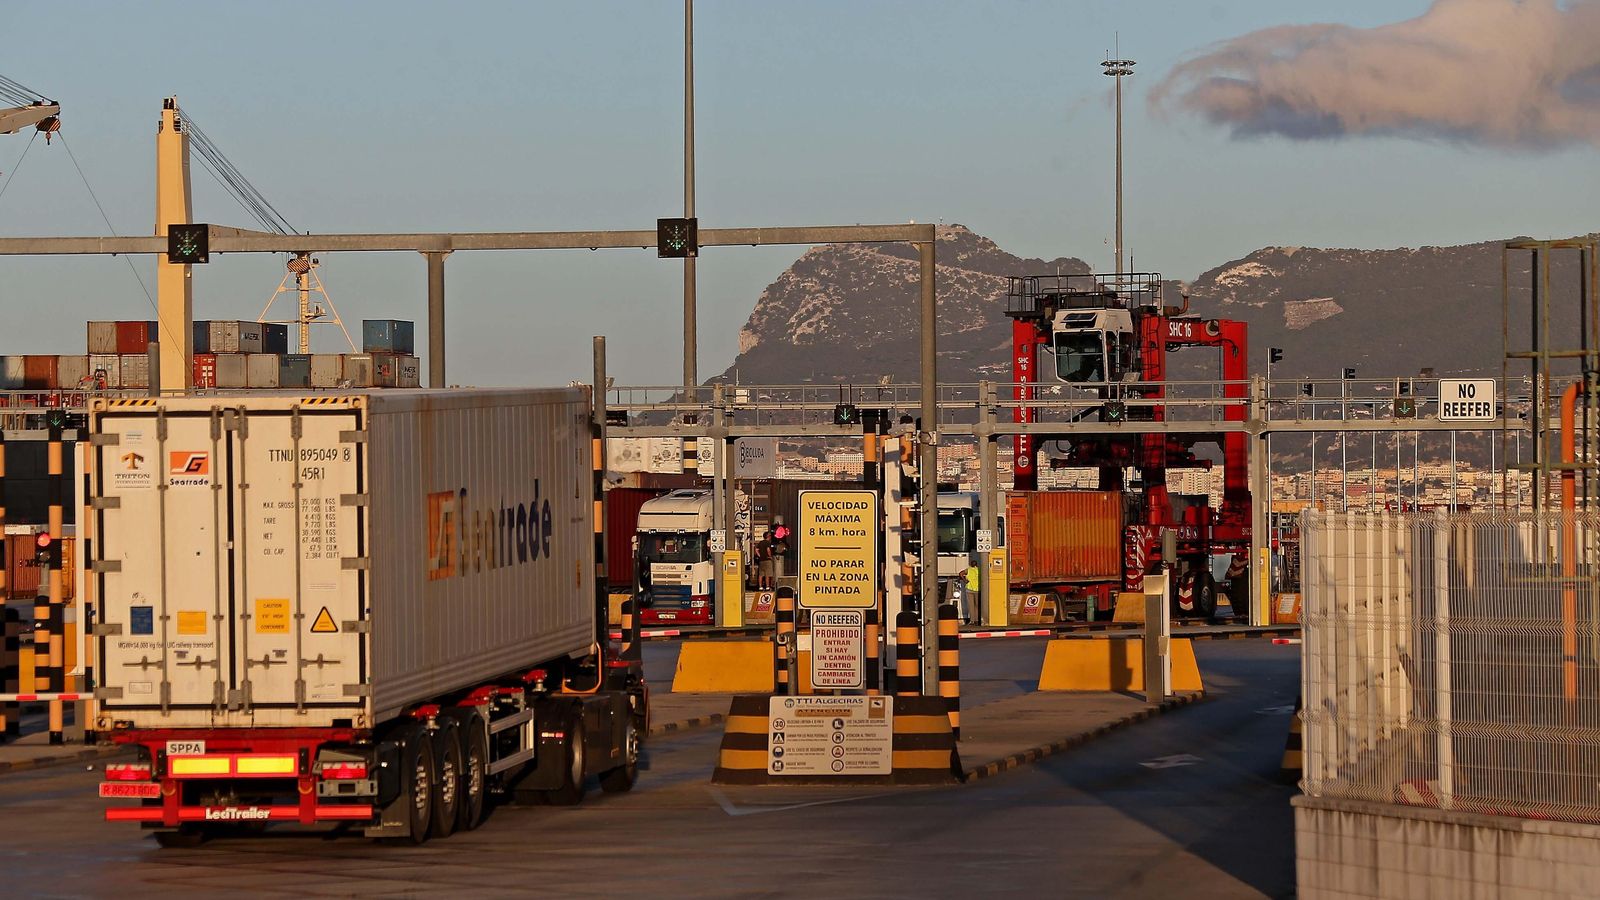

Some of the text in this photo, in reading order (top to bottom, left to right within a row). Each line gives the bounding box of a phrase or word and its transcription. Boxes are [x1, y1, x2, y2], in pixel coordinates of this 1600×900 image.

[1169, 321, 1192, 338] SHC 16
[1458, 383, 1476, 399] NO
[1443, 402, 1491, 417] REEFER
[268, 448, 351, 462] TTNU 895049 8
[301, 467, 325, 480] 45R1
[169, 478, 209, 486] Seatrade
[807, 501, 869, 510] VELOCIDAD
[815, 512, 861, 523] MÁXIMA
[809, 527, 867, 536] 8 km. hora
[810, 559, 865, 568] NO PARAR
[806, 572, 870, 581] EN LA ZONA
[814, 586, 861, 594] PINTADA
[816, 614, 860, 625] NO REEFERS
[815, 629, 860, 638] PROHIBIDO
[828, 653, 857, 661] CAMIÓN
[169, 743, 201, 753] SPPA
[205, 806, 270, 820] LeciTrailer
